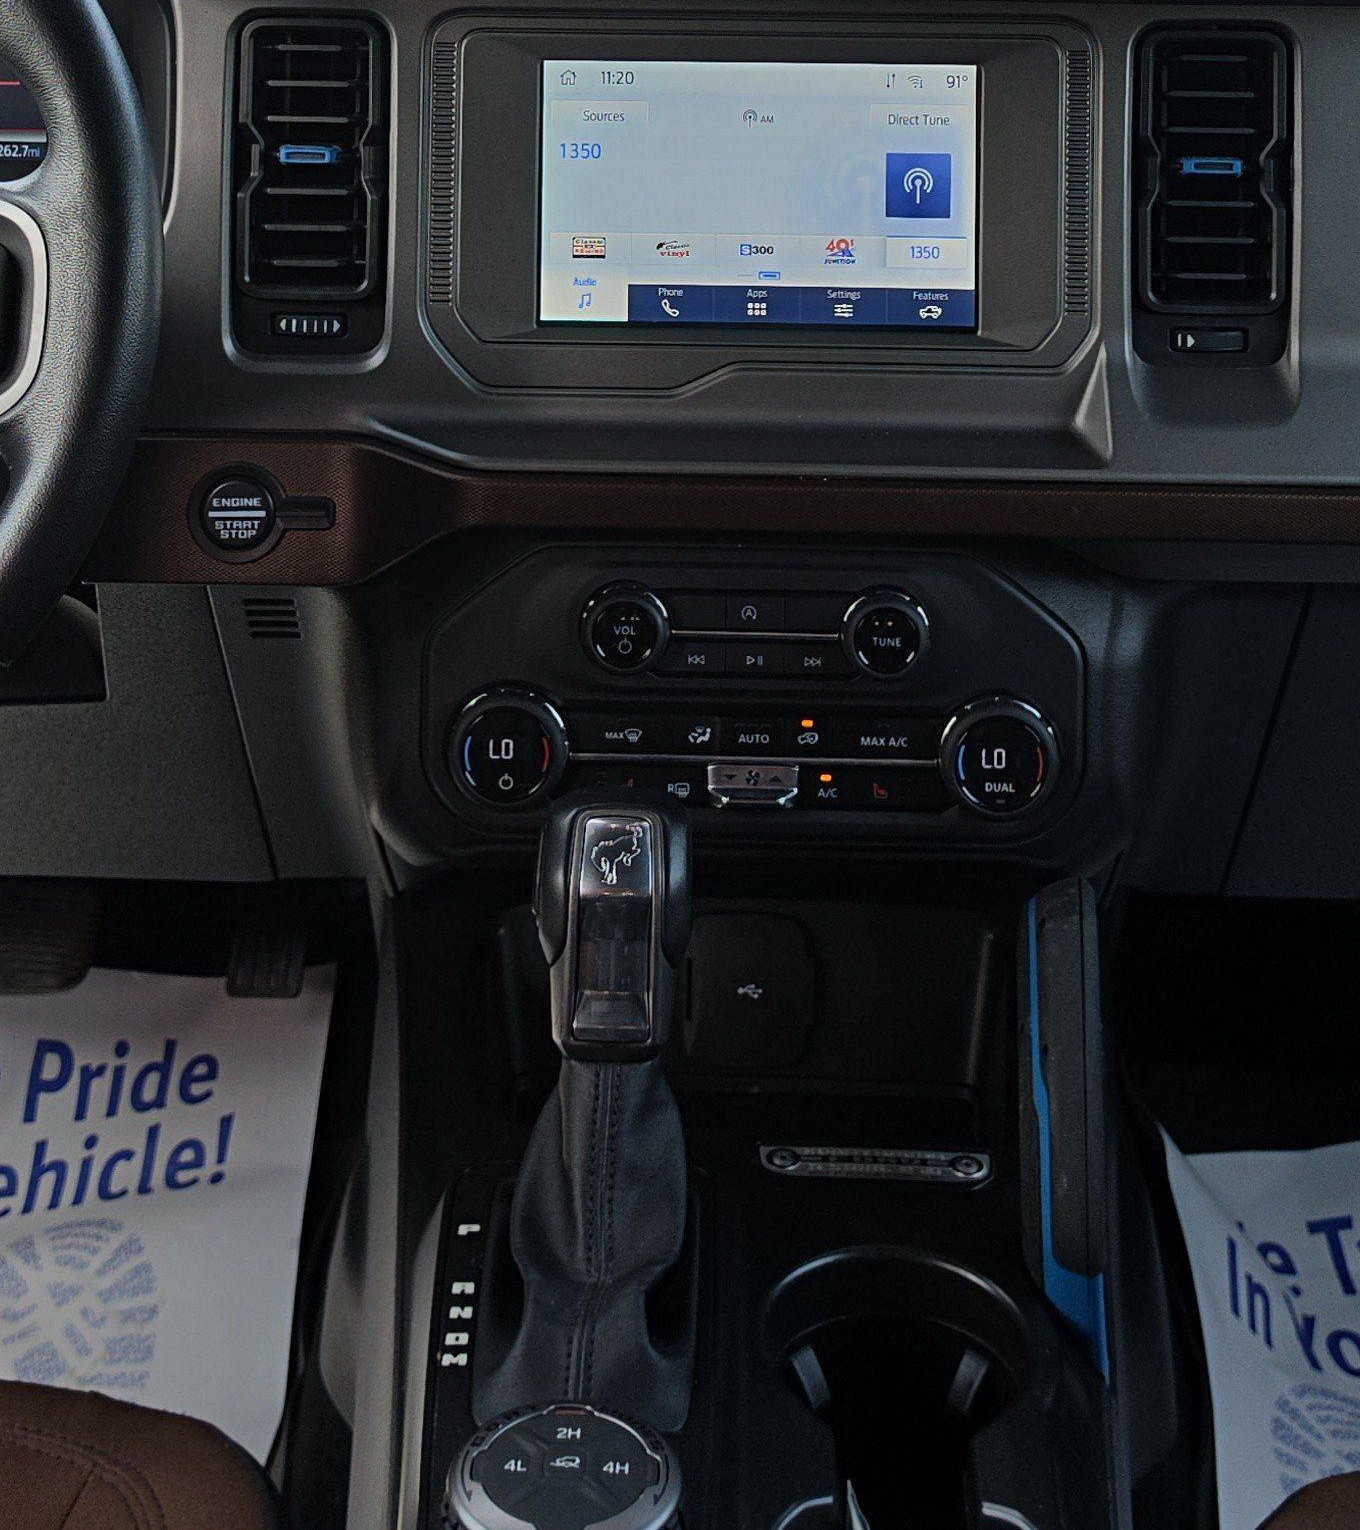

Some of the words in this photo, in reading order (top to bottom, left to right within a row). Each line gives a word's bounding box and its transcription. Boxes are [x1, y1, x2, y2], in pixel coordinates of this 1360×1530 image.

[600, 70, 635, 86] 11:20
[582, 109, 625, 123] Sources
[760, 115, 774, 124] AM
[888, 113, 920, 126] Direct
[923, 113, 950, 126] Tune
[559, 143, 602, 160] 1350
[910, 246, 940, 259] 1350
[572, 277, 597, 287] Audio
[658, 287, 684, 297] Phone
[746, 289, 768, 299] Apps
[826, 289, 861, 300] Settings
[913, 291, 949, 301] Features
[212, 497, 262, 507] ENGINE
[214, 520, 261, 530] START
[220, 529, 257, 539] STOP
[613, 625, 637, 636] VOL
[872, 636, 902, 648] TUNE
[605, 731, 624, 740] MAX
[738, 733, 770, 745] AUTO
[860, 736, 884, 747] MAX
[886, 736, 909, 749] A/C
[818, 787, 838, 799] A/C
[985, 782, 1016, 793] DUAL
[22, 1039, 220, 1126] Pride
[458, 1223, 481, 1235] P
[1226, 1233, 1274, 1352] In
[449, 1306, 473, 1319] N
[441, 1353, 468, 1366] M
[556, 1427, 581, 1440] 2H
[503, 1459, 527, 1472] 4L
[602, 1461, 630, 1475] 4H
